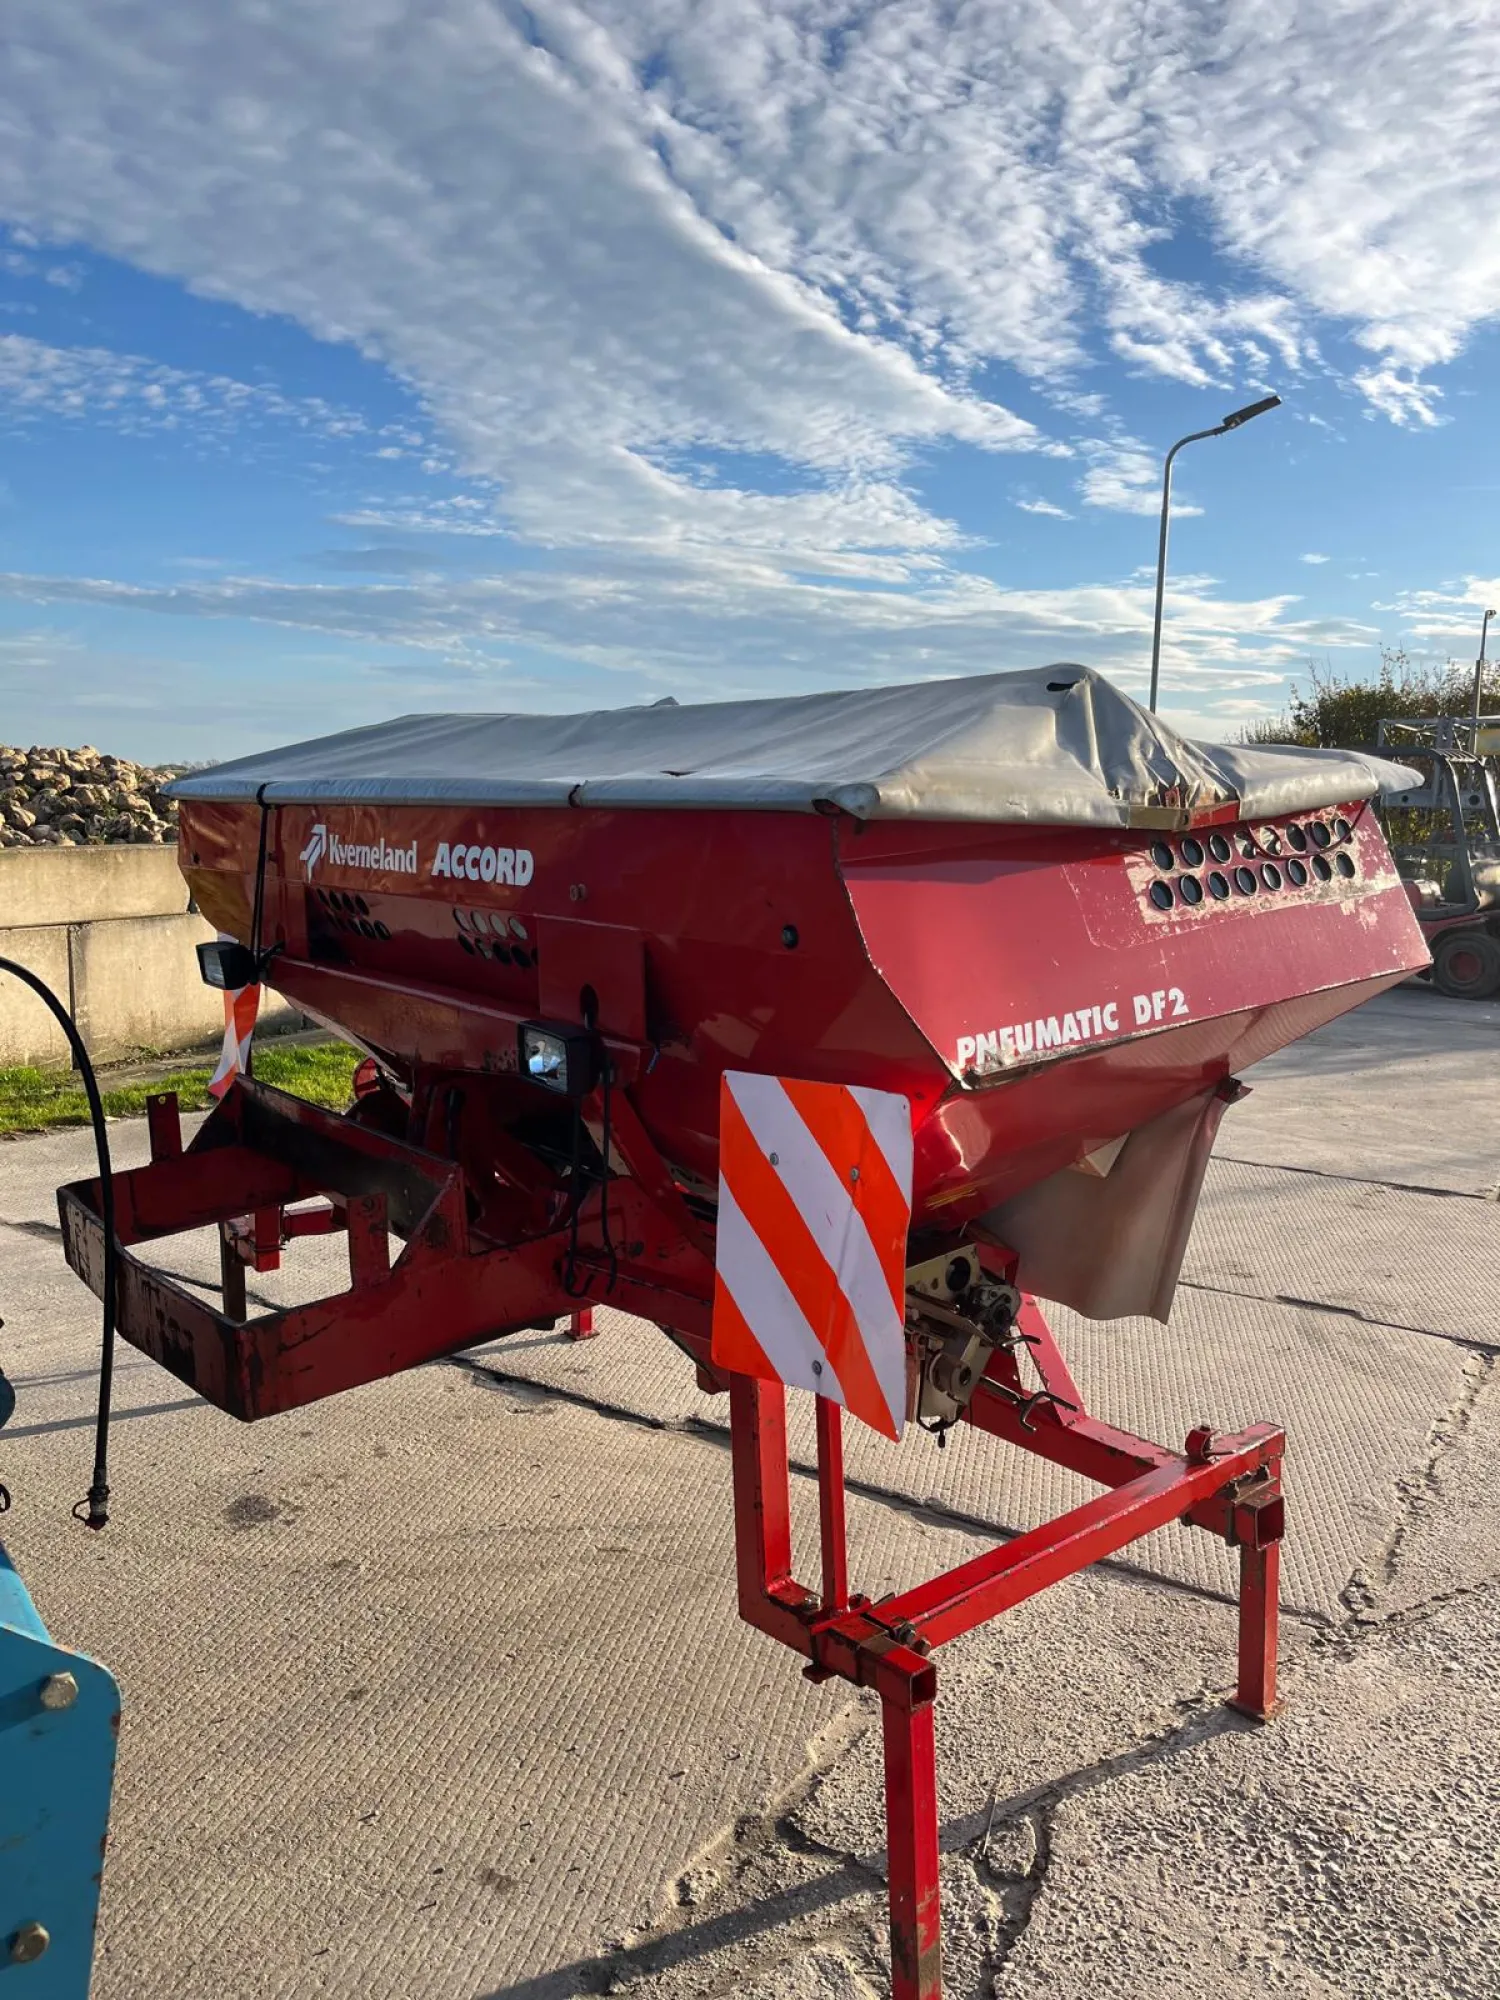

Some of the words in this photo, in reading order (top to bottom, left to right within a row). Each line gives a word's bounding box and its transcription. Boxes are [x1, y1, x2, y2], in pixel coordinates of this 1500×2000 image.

[329, 834, 417, 873] Kverneland
[431, 841, 535, 887] ACCORD
[1132, 987, 1190, 1026] DF2
